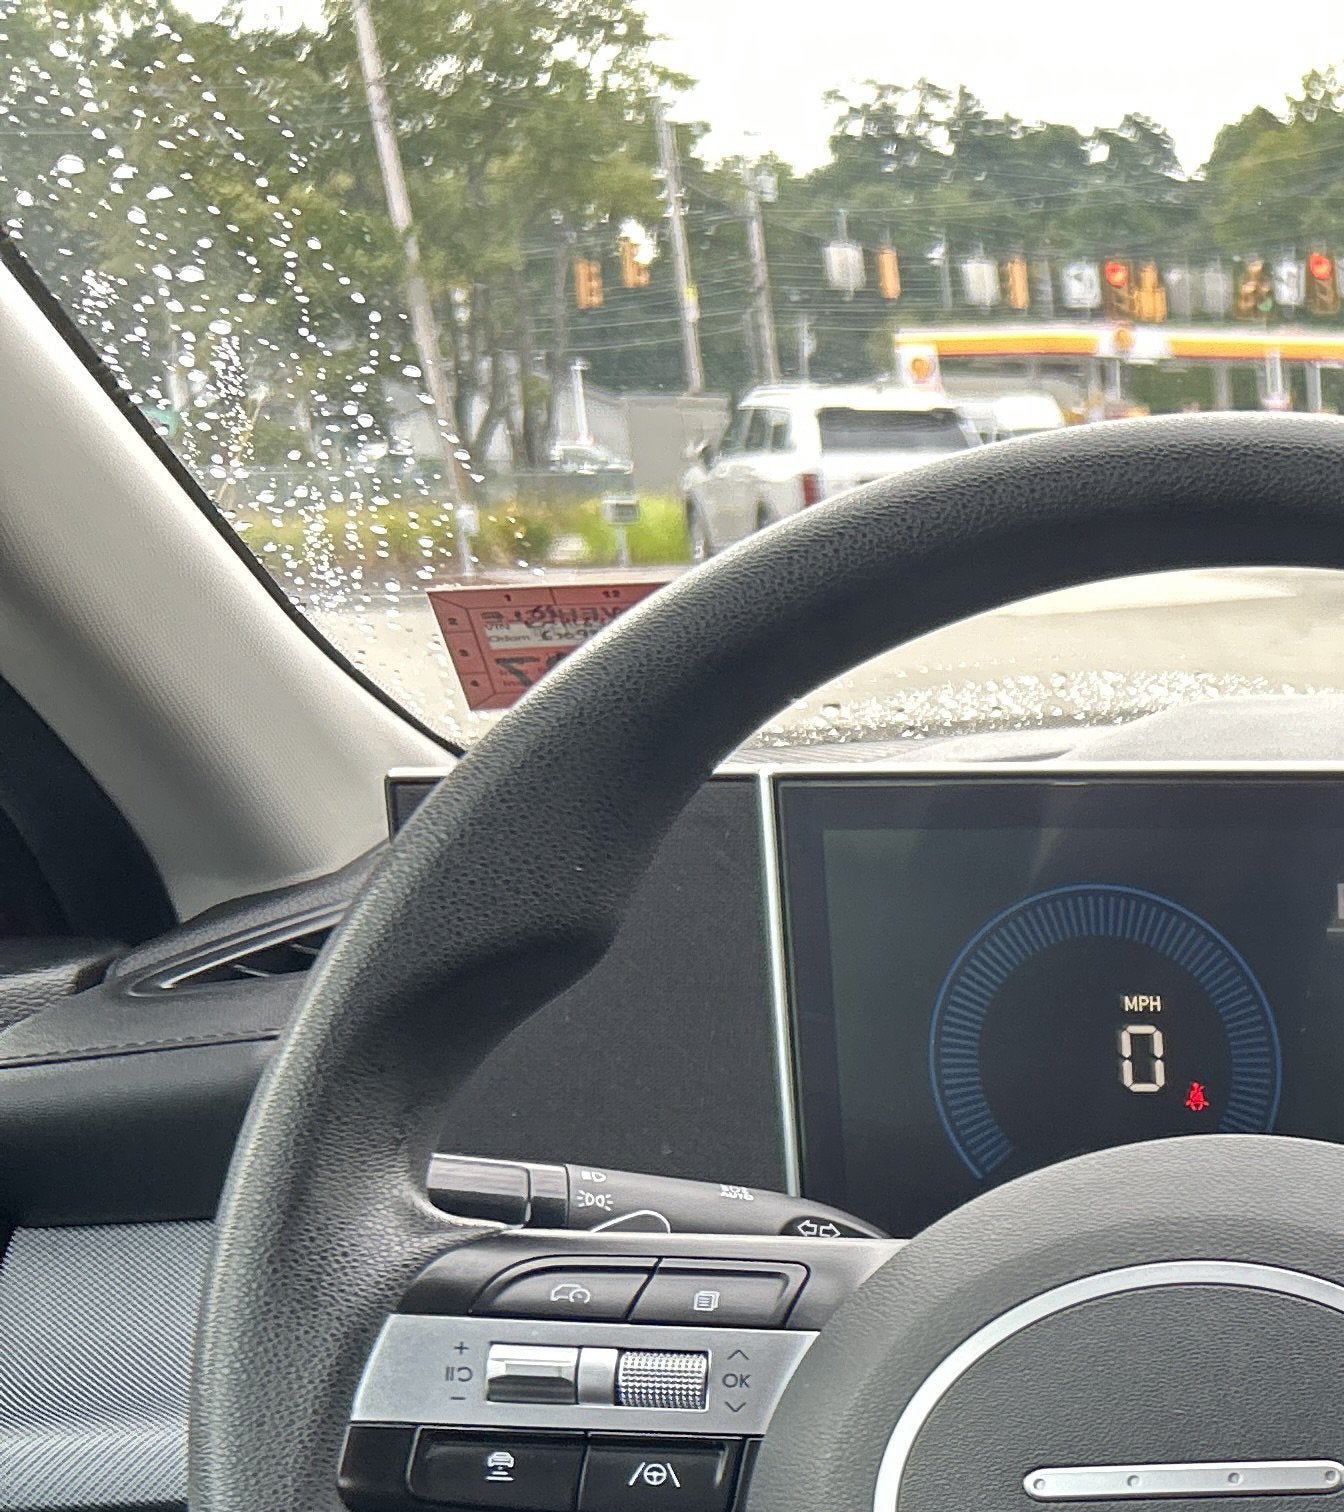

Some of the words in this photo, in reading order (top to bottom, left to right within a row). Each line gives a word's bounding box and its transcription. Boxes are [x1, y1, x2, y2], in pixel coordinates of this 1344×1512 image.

[1123, 995, 1161, 1012] MPH
[1121, 1025, 1164, 1092] 0
[722, 1373, 750, 1389] OK
